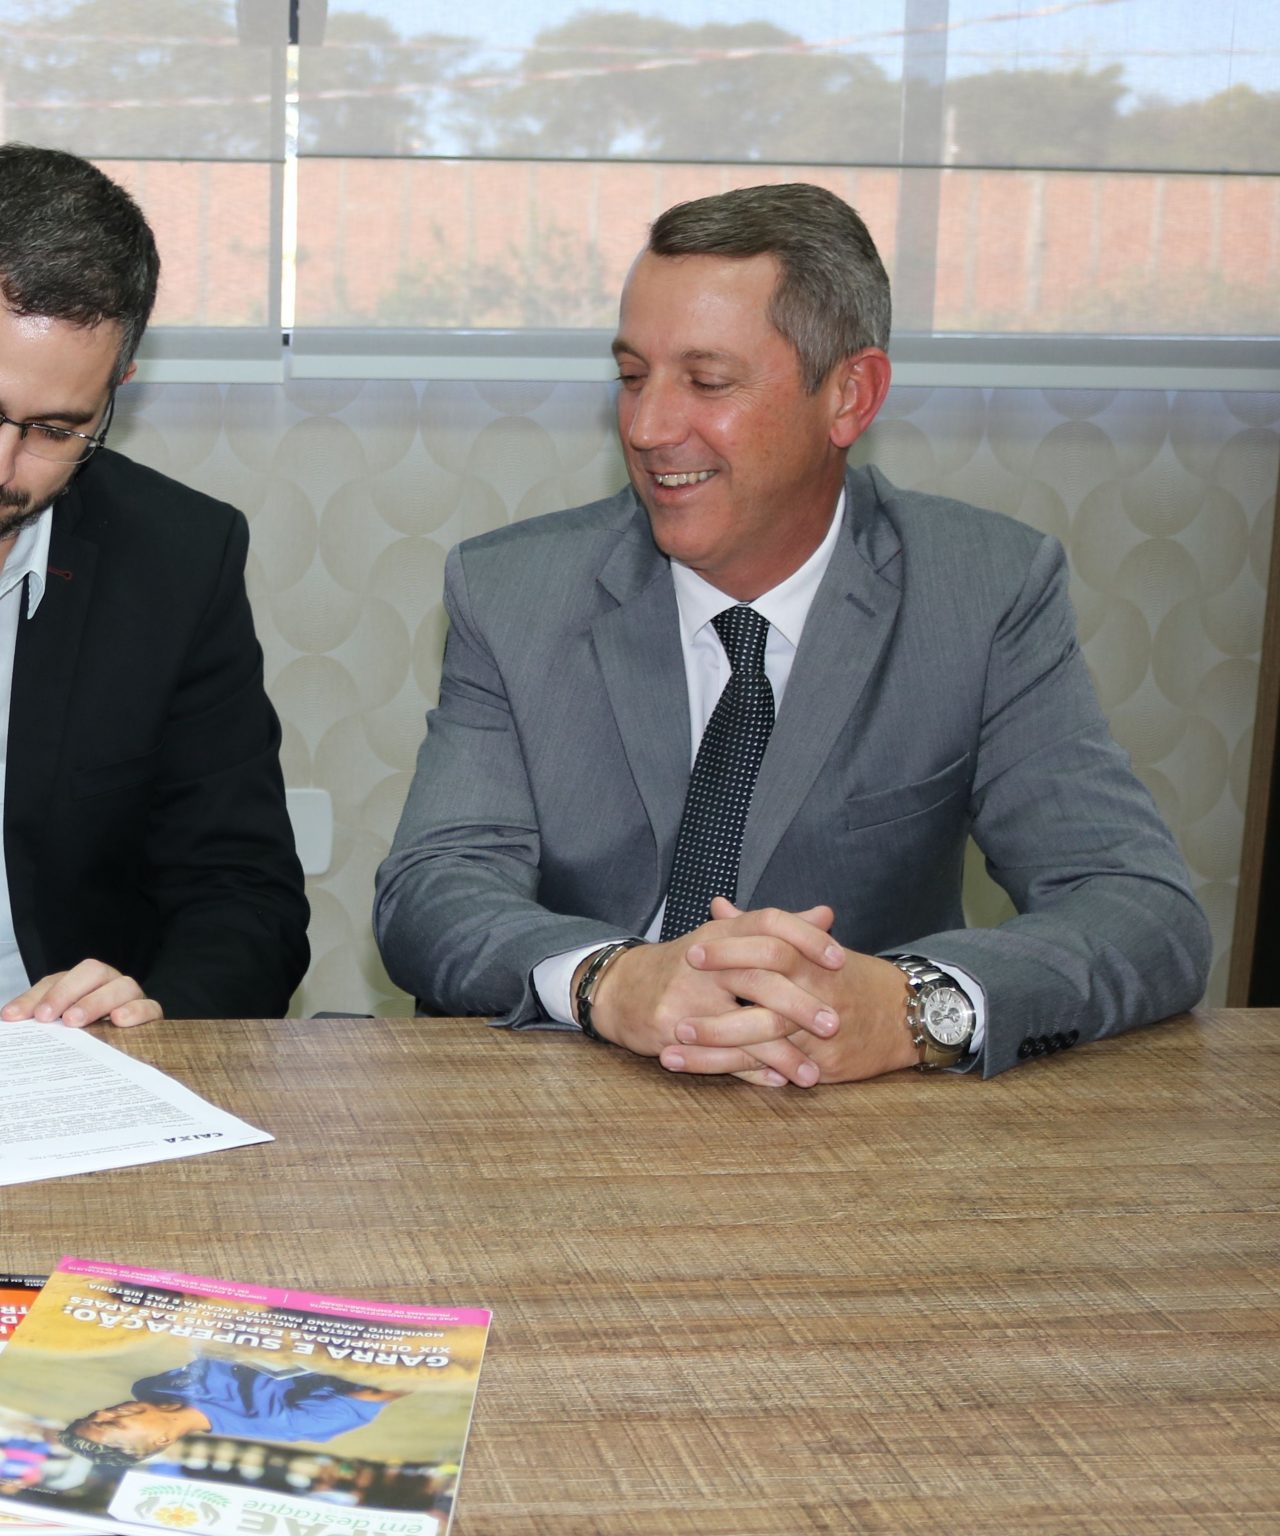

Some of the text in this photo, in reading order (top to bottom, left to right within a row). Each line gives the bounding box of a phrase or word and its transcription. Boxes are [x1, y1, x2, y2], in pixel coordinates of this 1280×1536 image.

[163, 1132, 224, 1143] CAIXA
[87, 1283, 144, 1299] HISTÓRIA
[145, 1293, 170, 1303] FAZ
[69, 1296, 132, 1313] APAES
[183, 1300, 239, 1314] ENCANTA
[121, 1296, 404, 1342] MAIOR FESTA DE INCLUSÃO PELO ESPORTE DO
[137, 1308, 178, 1322] DAS
[183, 1316, 283, 1337] ESPECIAIS
[305, 1319, 366, 1332] APAEANO
[367, 1327, 444, 1338] MOVIMENTO
[62, 1305, 449, 1367] GARRA E SUPERAÇÃO:
[288, 1331, 411, 1352] OLIMPÍADAS
[243, 1500, 370, 1530] destaque
[378, 1523, 423, 1534] em
